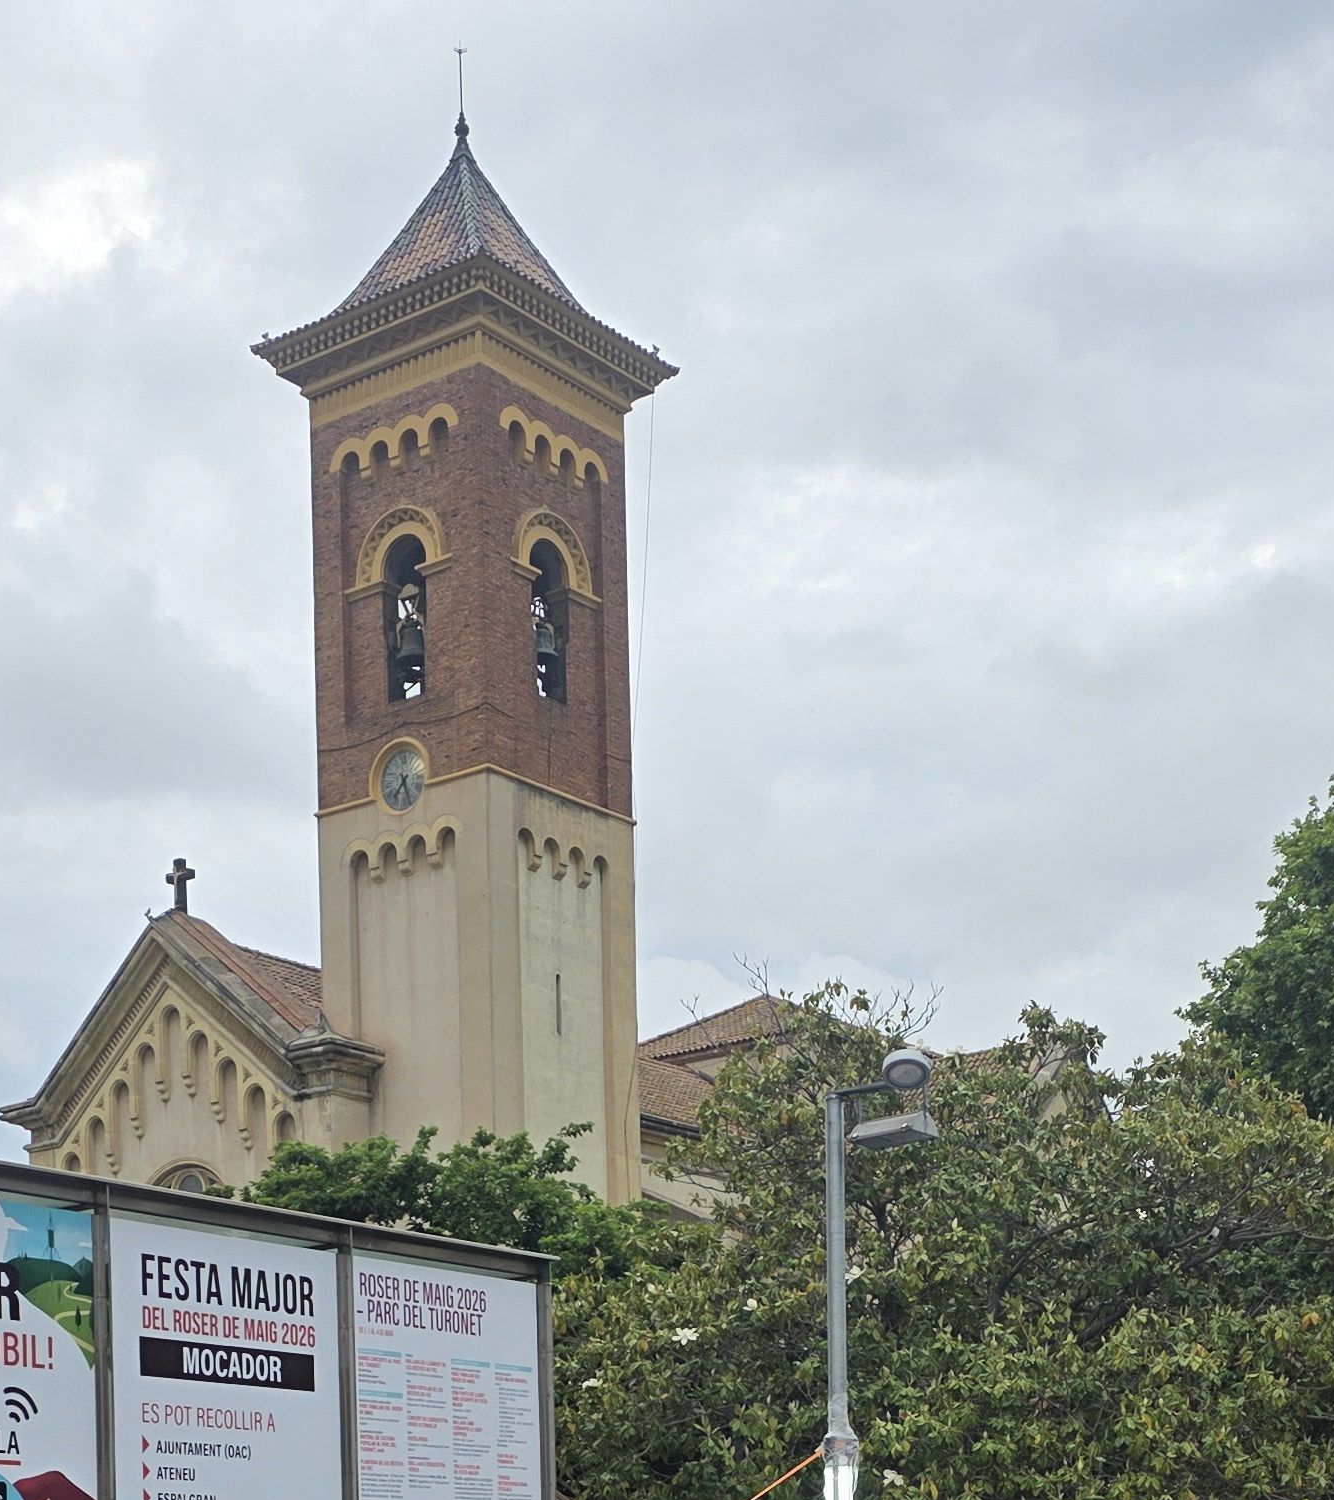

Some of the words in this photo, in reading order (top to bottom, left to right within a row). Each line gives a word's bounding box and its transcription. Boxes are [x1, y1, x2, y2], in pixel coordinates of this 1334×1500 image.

[141, 1253, 223, 1306] FESTA
[231, 1266, 314, 1317] MAJOR
[359, 1272, 400, 1301] ROSER
[404, 1279, 419, 1304] DE
[423, 1282, 454, 1308] MAIG
[457, 1288, 486, 1313] 2026
[142, 1305, 169, 1331] DEL
[173, 1309, 218, 1337] ROSER
[223, 1315, 239, 1339] DE
[244, 1317, 277, 1343] MAIG
[281, 1323, 315, 1348] 2026
[367, 1299, 400, 1326] PARC
[403, 1304, 426, 1330] DEL
[428, 1307, 483, 1337] TURONET
[183, 1347, 282, 1382] MOCADOR
[142, 1403, 160, 1424] ES
[165, 1404, 192, 1427] POT
[196, 1407, 263, 1432] RECOLLIR
[267, 1413, 276, 1432] A
[156, 1440, 222, 1457] AJUNTAMENT
[224, 1443, 252, 1460] (OAC)
[156, 1467, 196, 1481] ATENEU
